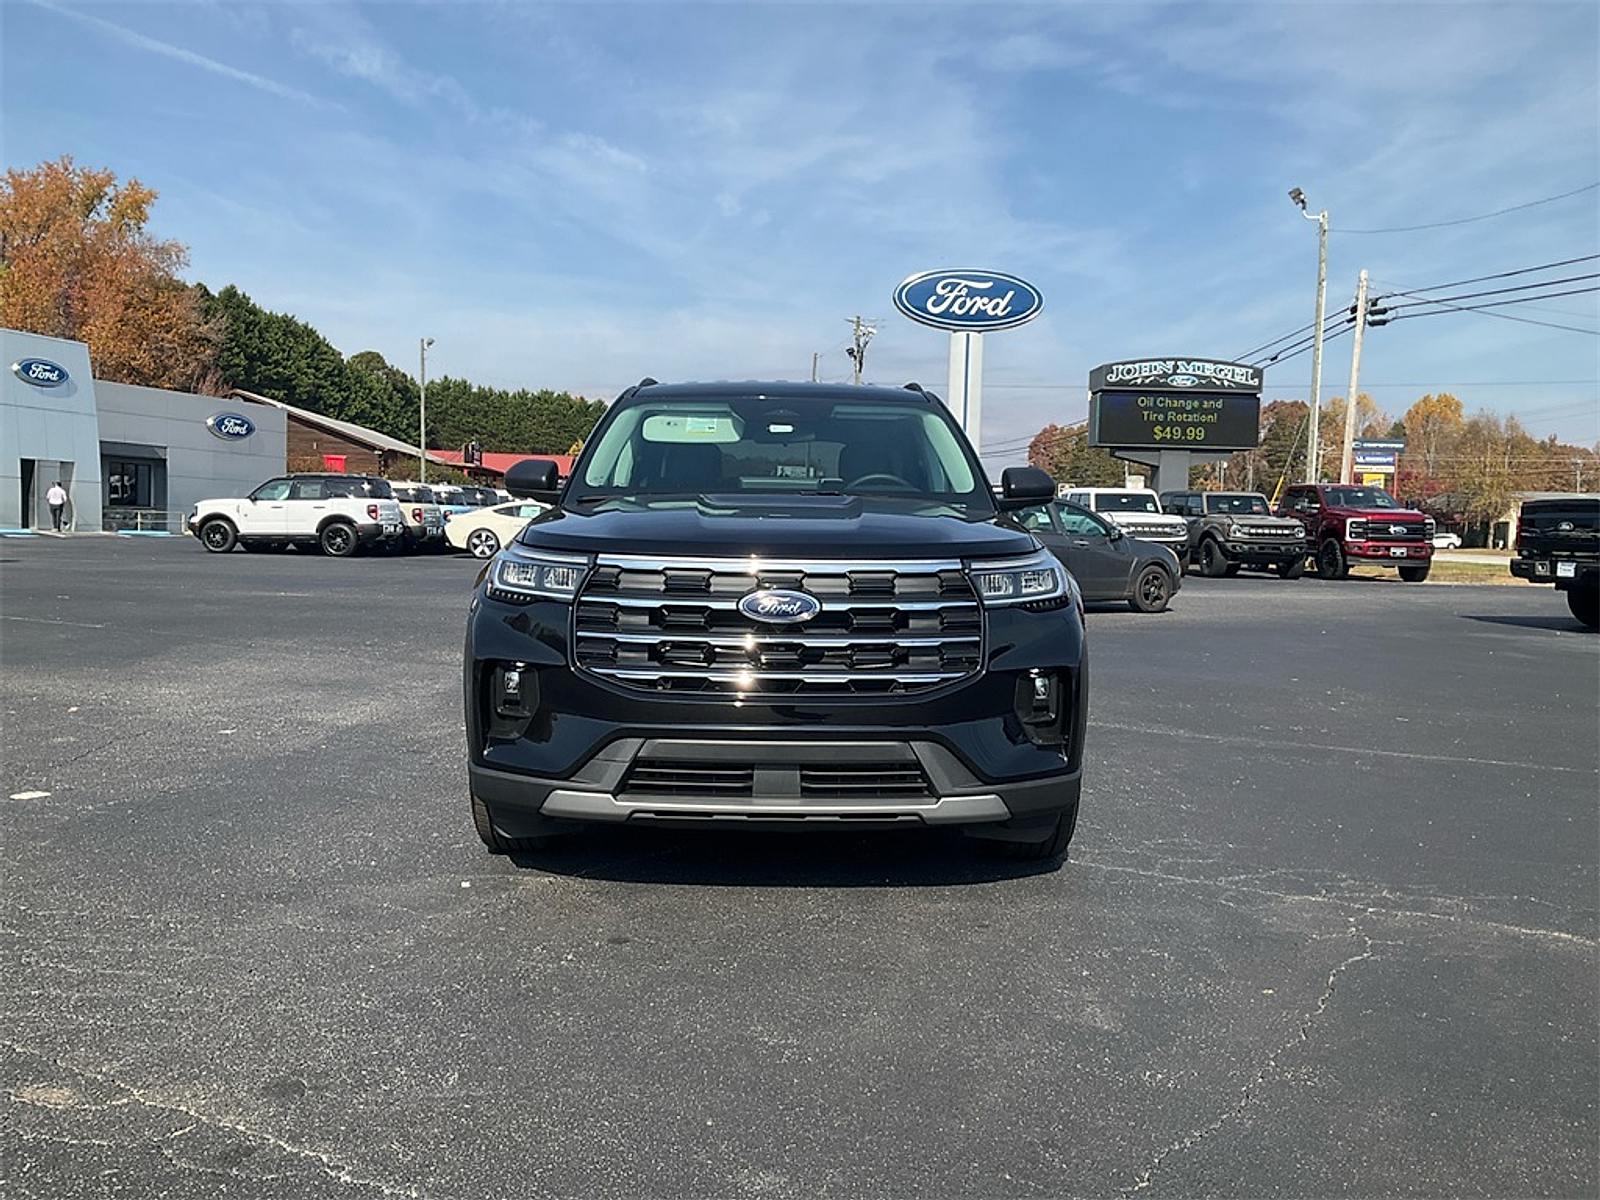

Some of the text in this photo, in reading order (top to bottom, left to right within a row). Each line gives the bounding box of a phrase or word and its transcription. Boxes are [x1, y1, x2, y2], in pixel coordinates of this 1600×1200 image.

[926, 278, 1015, 317] Ford
[29, 363, 59, 380] Ford
[1106, 360, 1259, 386] JOHN MEGEL
[1137, 396, 1223, 410] Oil Change and
[1142, 410, 1217, 423] Tire Rotation!
[222, 418, 248, 434] Ford
[1153, 425, 1205, 441] $49.99
[757, 596, 802, 614] Ford
